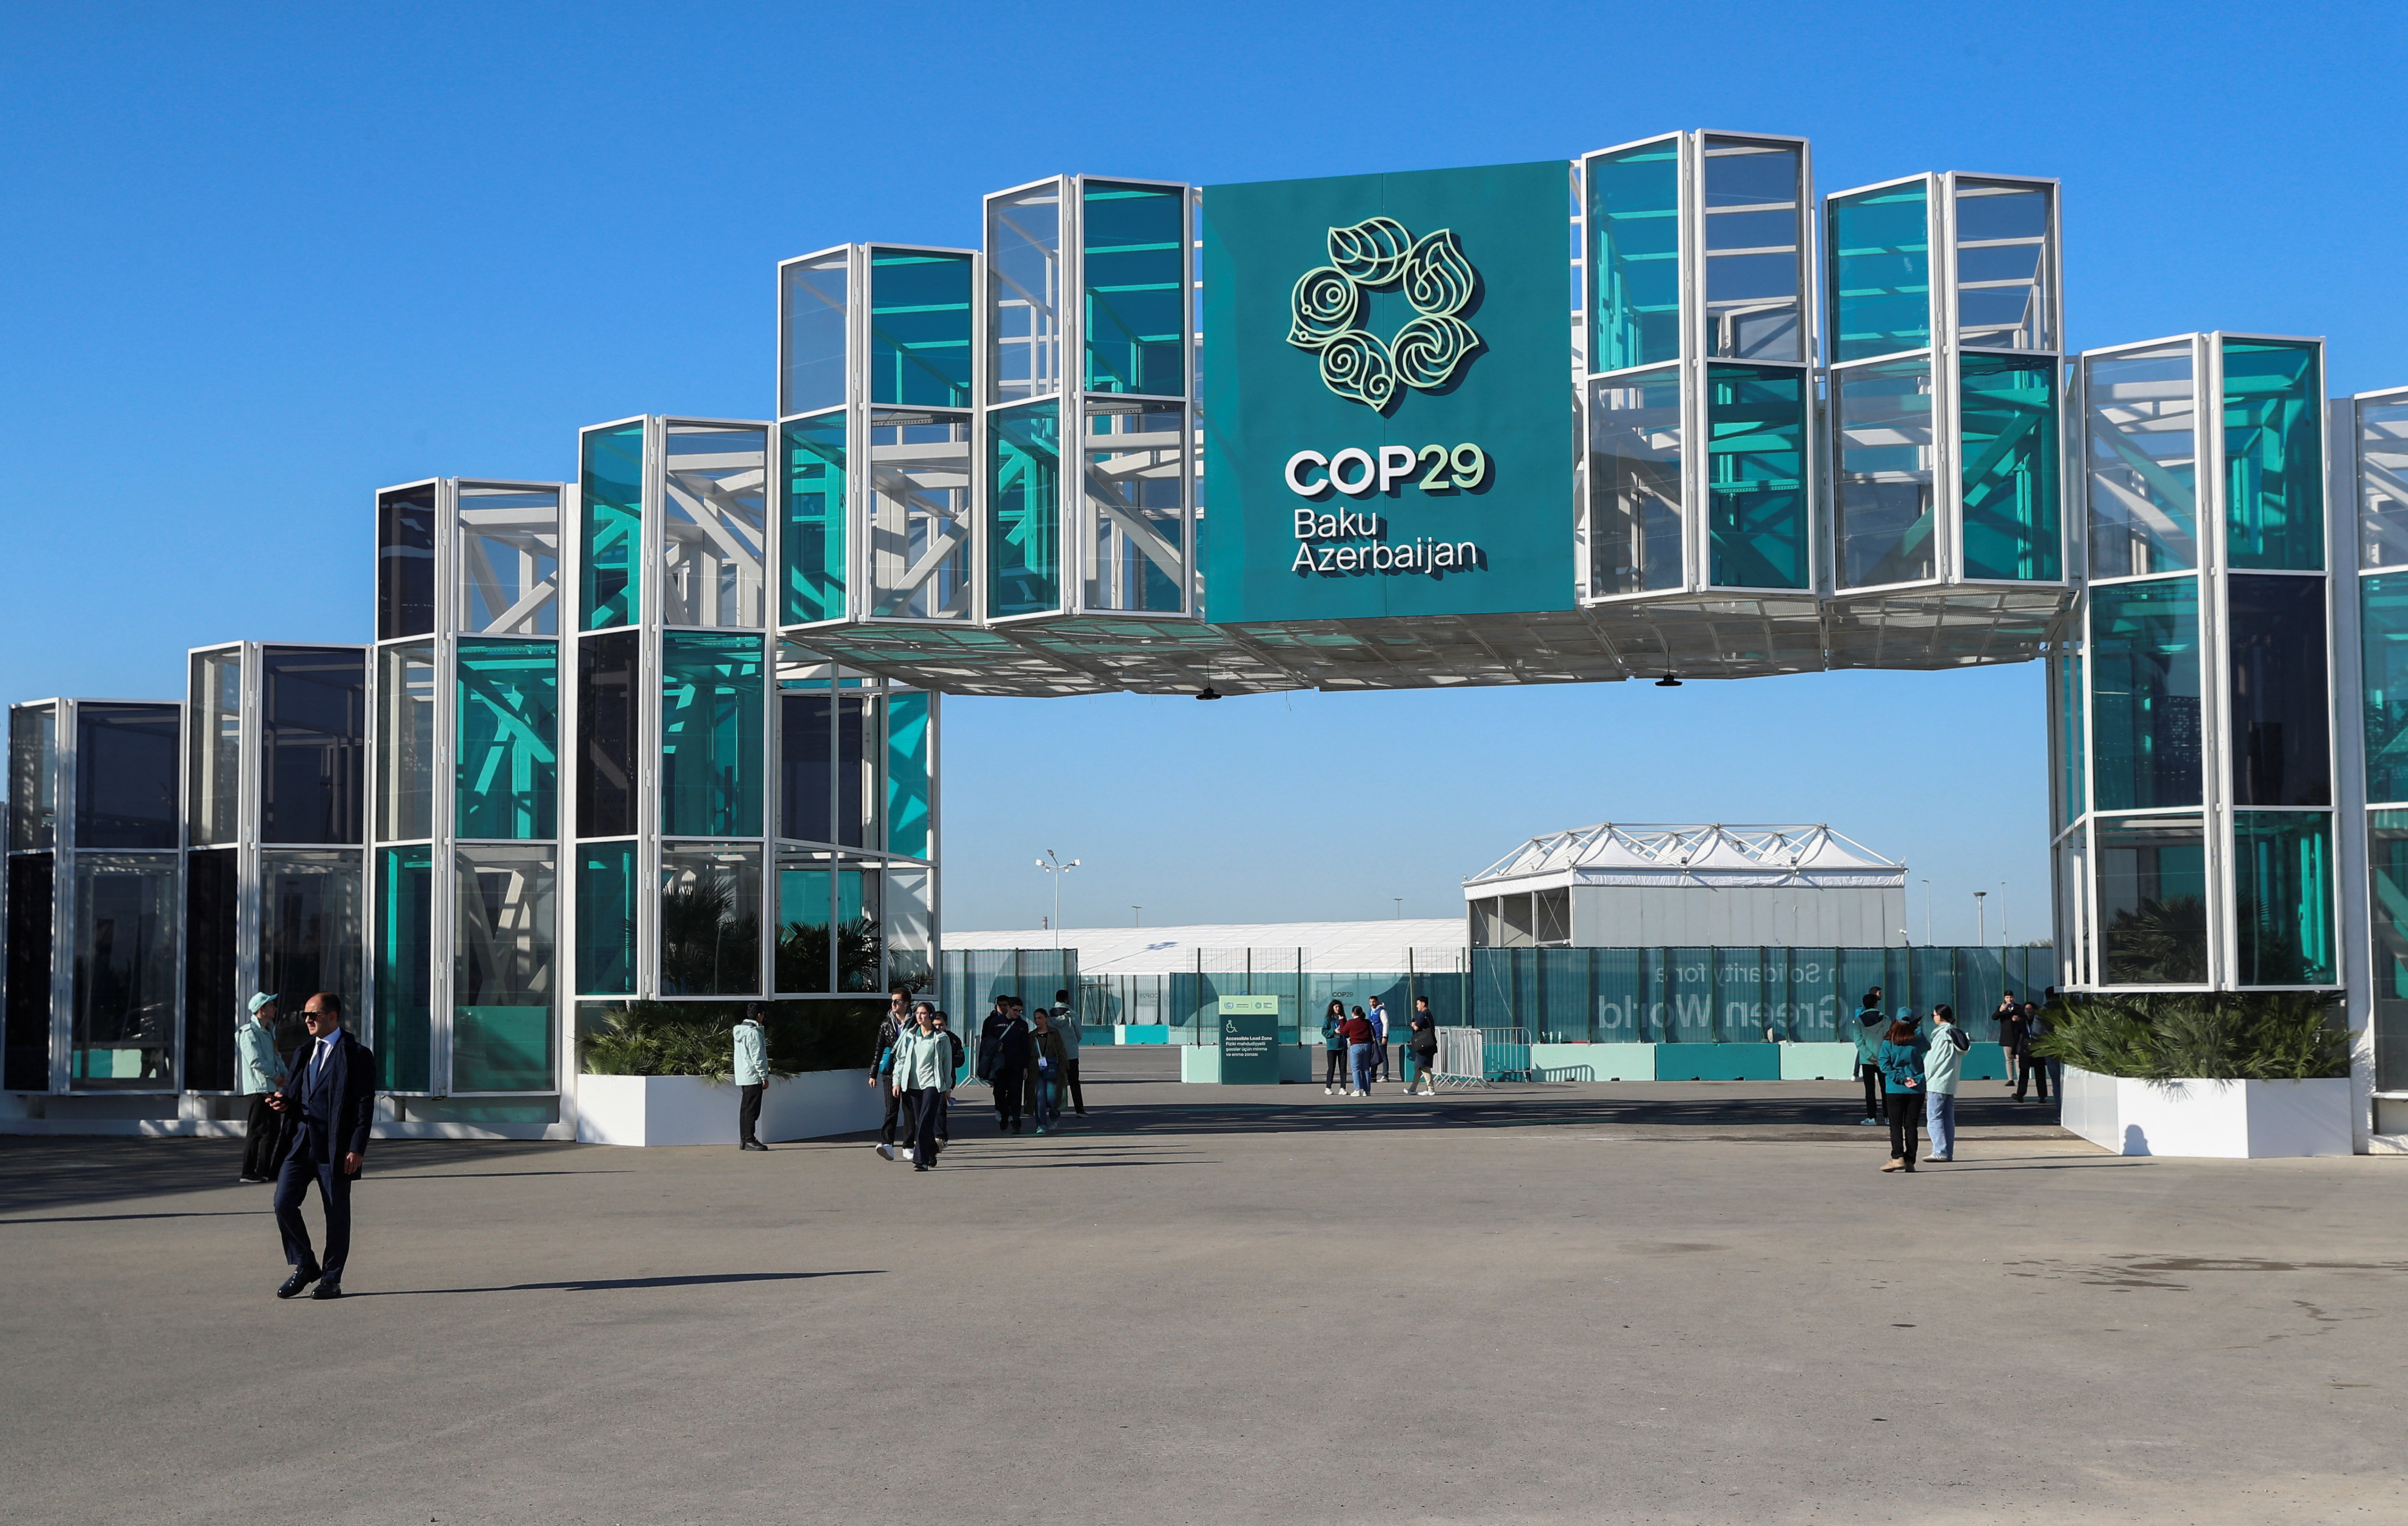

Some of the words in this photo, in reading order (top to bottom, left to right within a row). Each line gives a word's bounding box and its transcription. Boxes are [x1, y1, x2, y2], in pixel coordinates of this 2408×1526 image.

[1284, 442, 1485, 497] COP29
[1293, 507, 1378, 539] Baku
[1291, 536, 1477, 574] Azerbaijan
